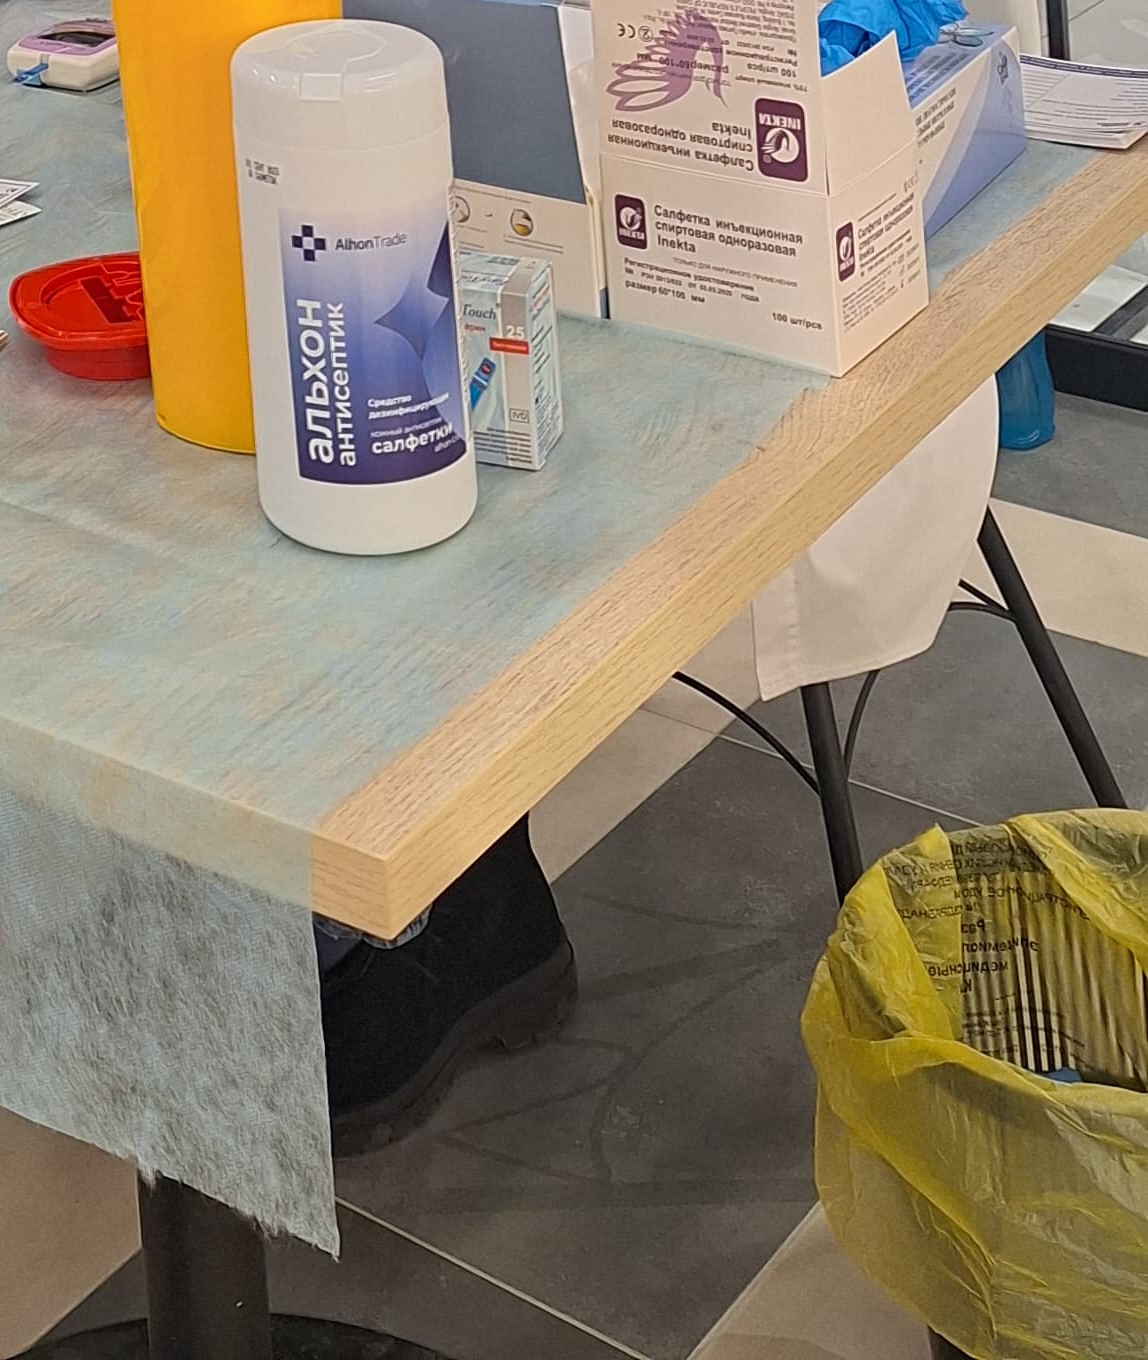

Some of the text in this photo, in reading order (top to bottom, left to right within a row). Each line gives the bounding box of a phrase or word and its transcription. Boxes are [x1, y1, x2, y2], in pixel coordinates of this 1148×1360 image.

[781, 68, 796, 78] 100
[711, 122, 751, 139] Inekta
[759, 112, 801, 130] INEKTA
[612, 119, 752, 155] спиртовая одноразовая
[608, 134, 754, 171] Салфетка инъекционная
[654, 204, 803, 244] Салфетка инъекционная
[335, 232, 407, 252] AlhonTrade
[655, 221, 796, 257] спиртовая одноразовая
[657, 235, 696, 253] Inekta
[625, 280, 657, 296] размер
[772, 312, 788, 323] 100
[505, 325, 525, 339] 25
[297, 299, 335, 464] альхон
[327, 302, 357, 467] антисептик
[372, 422, 452, 454] салфетки
